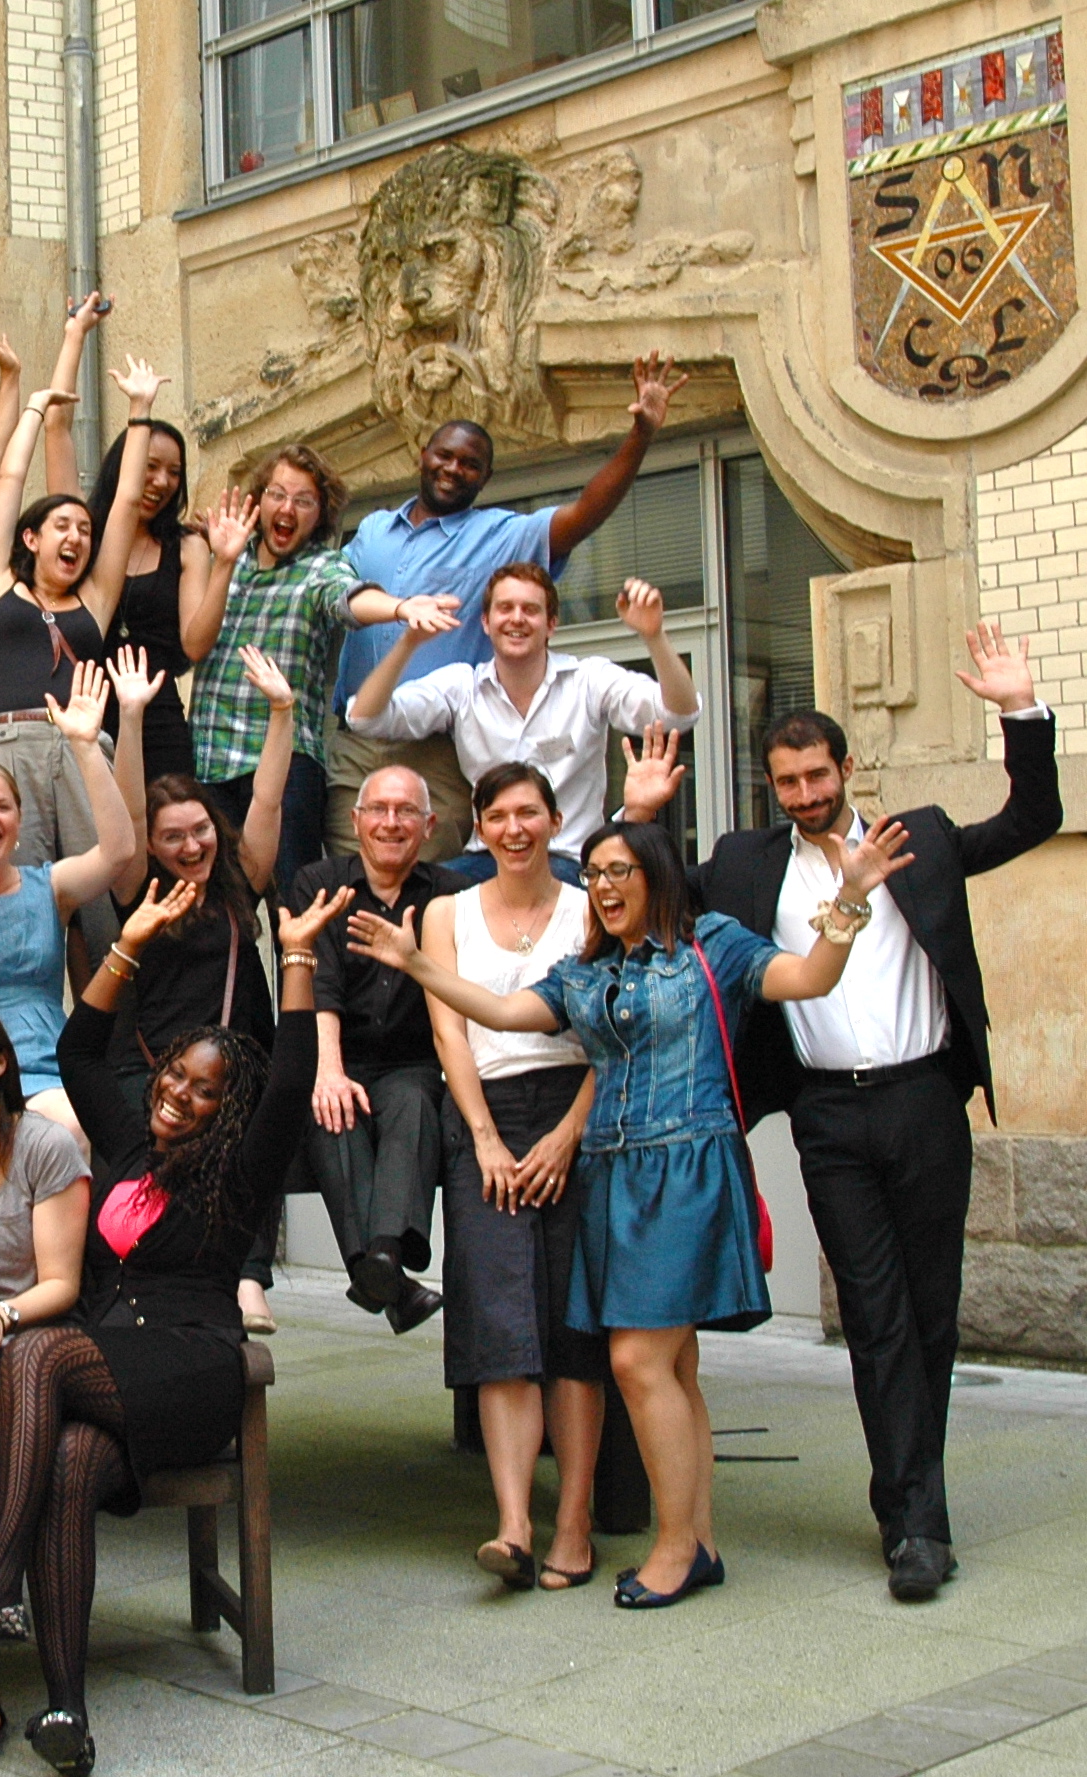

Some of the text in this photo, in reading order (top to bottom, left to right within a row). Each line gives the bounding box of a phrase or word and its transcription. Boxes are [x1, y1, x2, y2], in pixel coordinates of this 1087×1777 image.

[874, 171, 920, 239] S
[933, 241, 984, 280] 06
[903, 317, 940, 368] C
